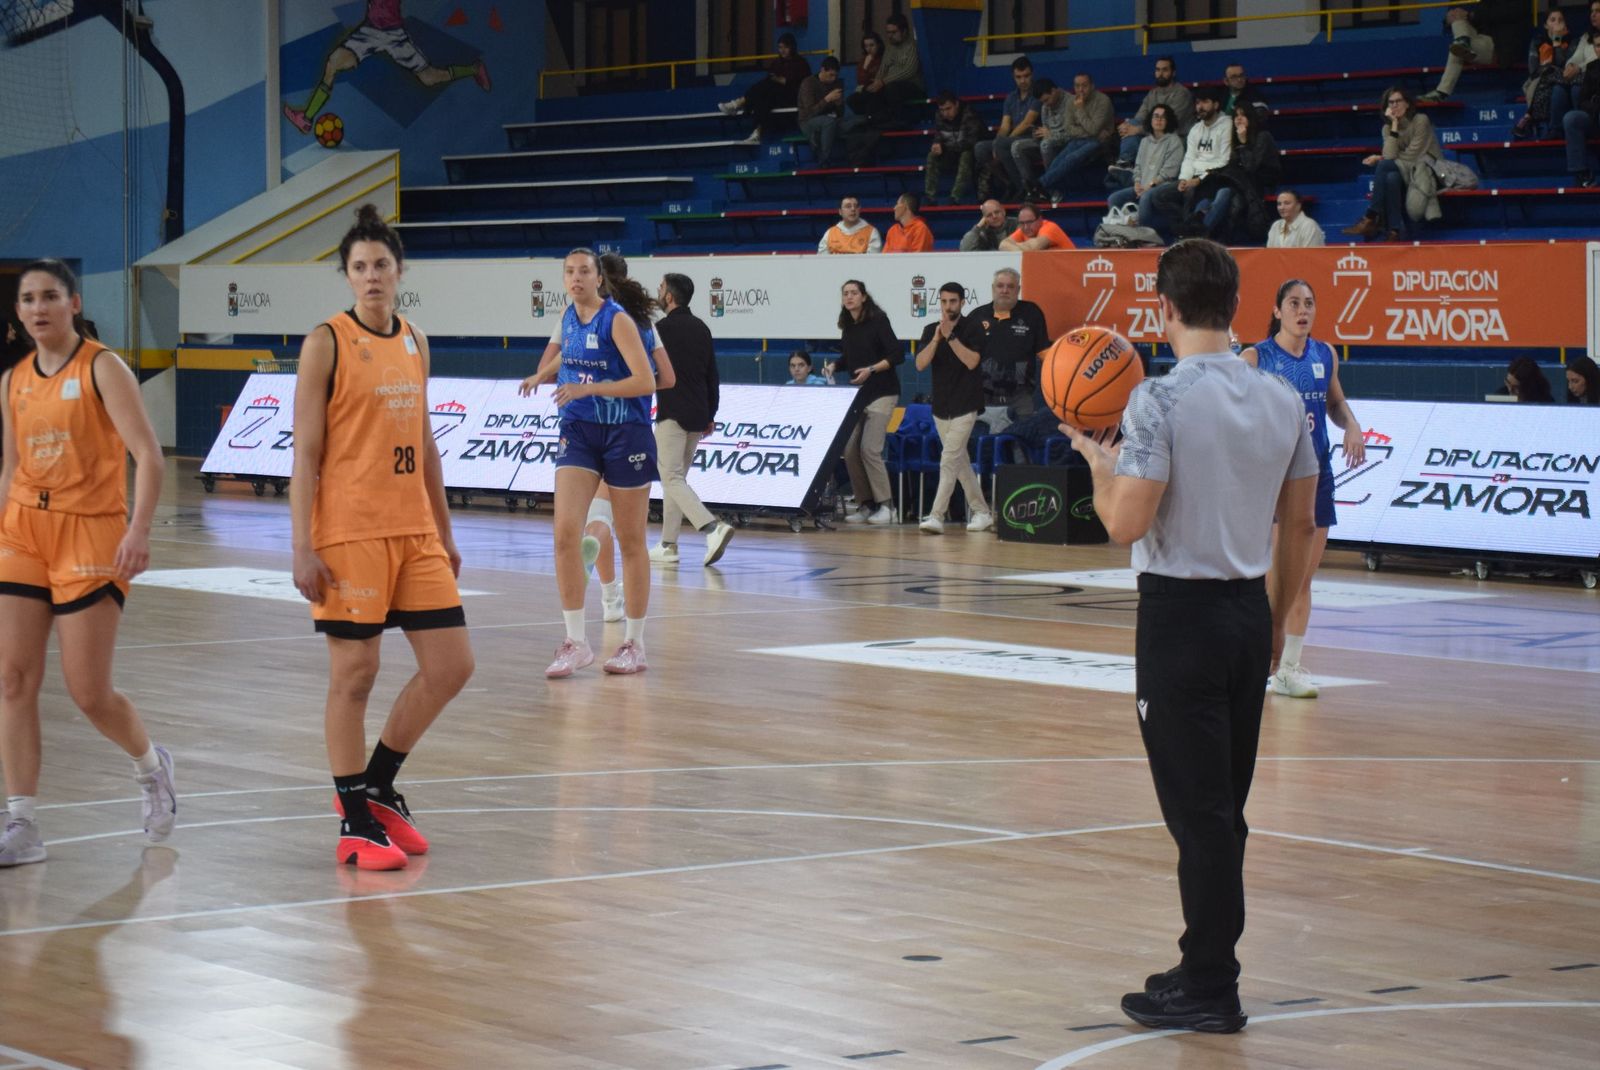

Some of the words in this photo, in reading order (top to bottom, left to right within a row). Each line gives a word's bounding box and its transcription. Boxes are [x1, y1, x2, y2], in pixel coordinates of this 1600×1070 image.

[238, 292, 271, 308] ZAMORA
[725, 289, 770, 306] ZAMORA
[1385, 308, 1510, 341] ZAMORA
[484, 414, 560, 430] DIPUTACI
[393, 445, 416, 475] 28
[459, 439, 559, 464] ZAMOR
[691, 448, 800, 477] AMORA
[1390, 480, 1591, 519] ZAMORA
